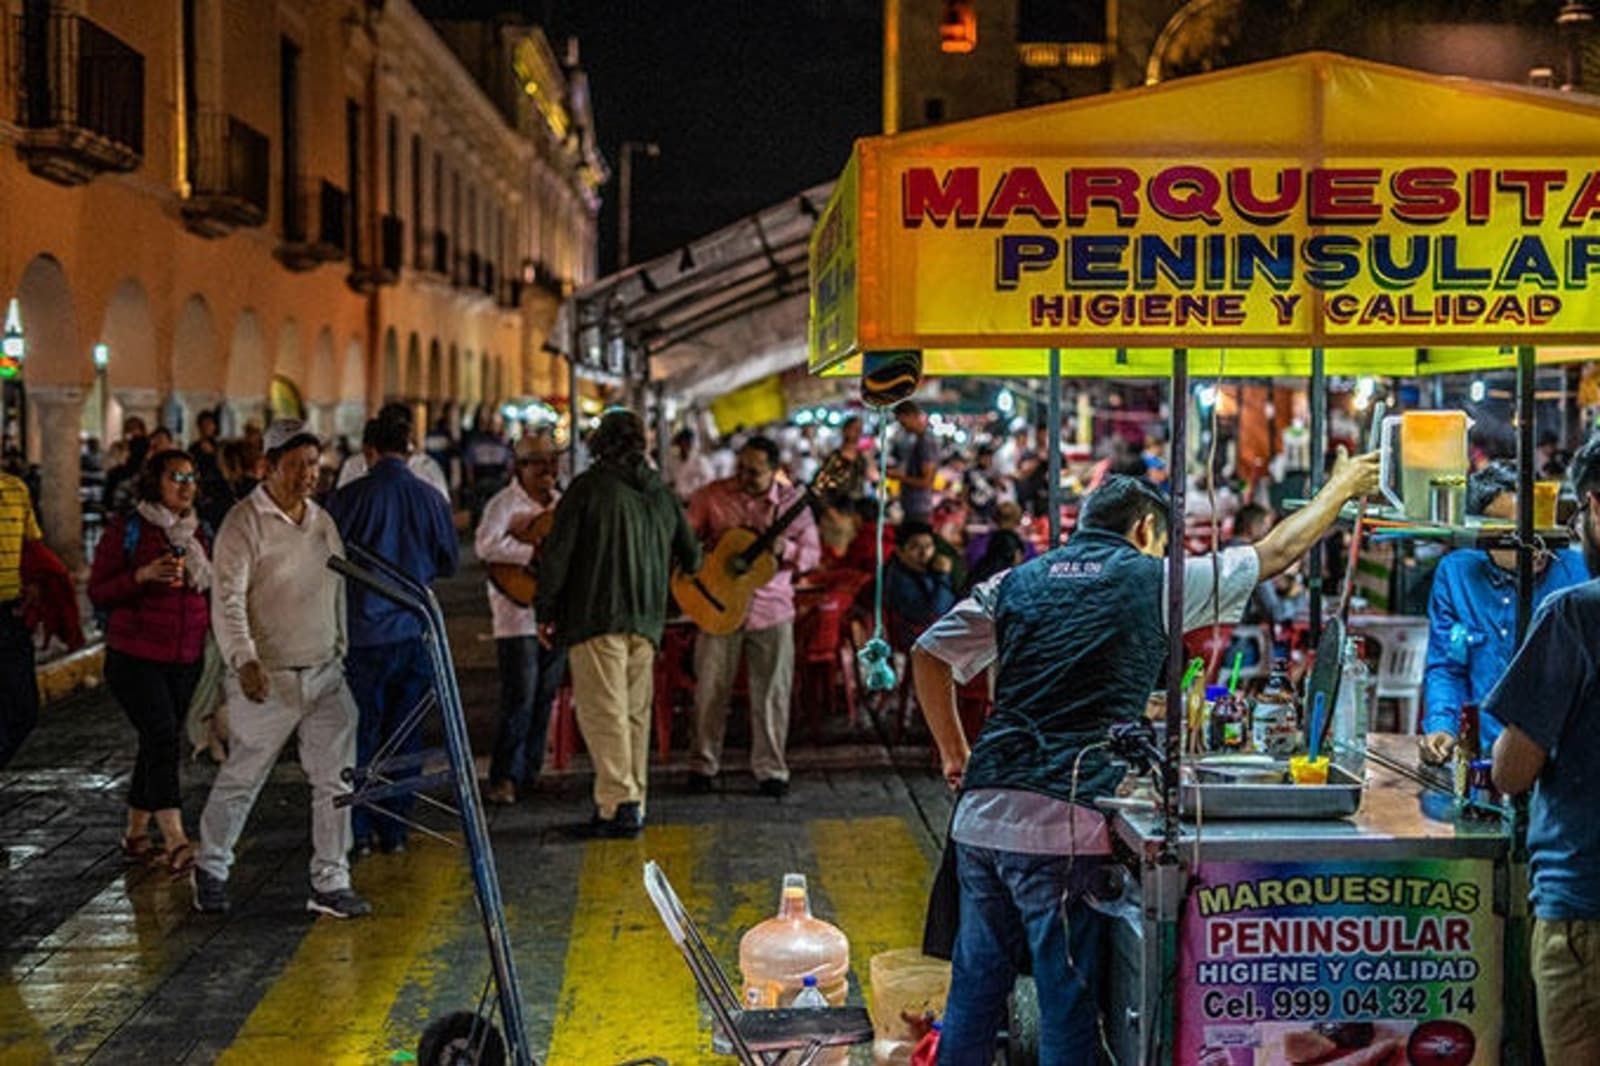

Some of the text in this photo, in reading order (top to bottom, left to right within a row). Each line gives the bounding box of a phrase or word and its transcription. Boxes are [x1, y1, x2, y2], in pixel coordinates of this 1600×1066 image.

[1030, 293, 1562, 326] HIGIENE Y CALIDAD
[1197, 875, 1479, 915] MARQUESITAS
[1208, 917, 1473, 957] PENINSULAR
[1198, 960, 1478, 984] HIGIENE Y CALIDAD
[1203, 986, 1477, 1018] Cel. 999 04 32 14
